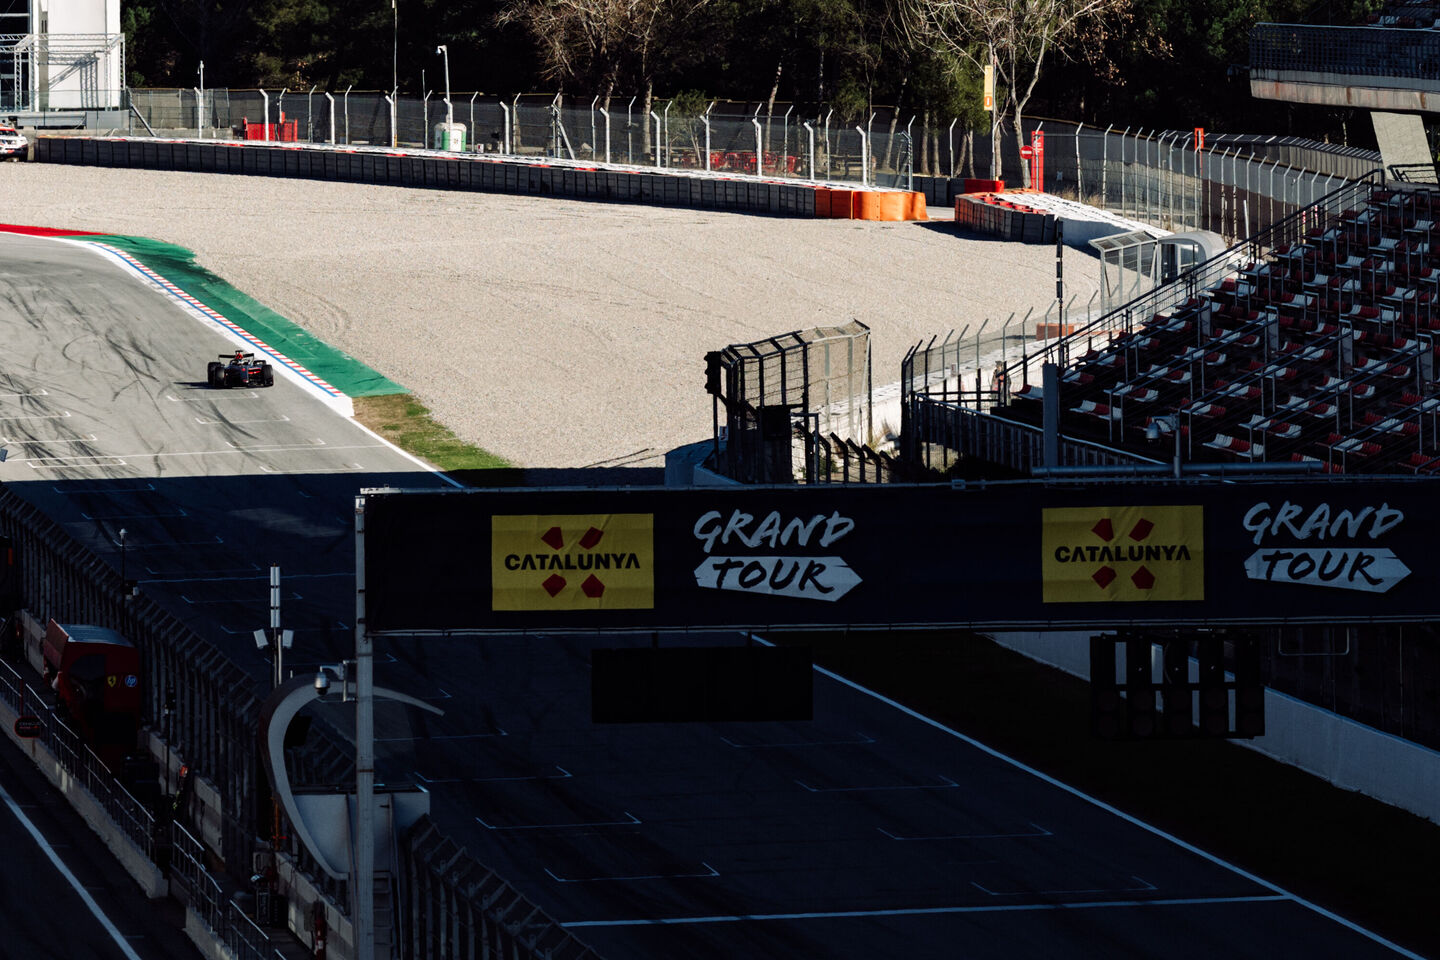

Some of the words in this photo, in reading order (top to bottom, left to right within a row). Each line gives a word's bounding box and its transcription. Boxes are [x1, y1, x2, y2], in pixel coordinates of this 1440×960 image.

[693, 509, 855, 553] GRAND
[1242, 500, 1404, 546] GRAND
[504, 552, 641, 571] CATALUNYA
[1054, 545, 1191, 563] CATALUNYA
[1262, 549, 1385, 586] TOUR
[712, 557, 835, 594] TOUR
